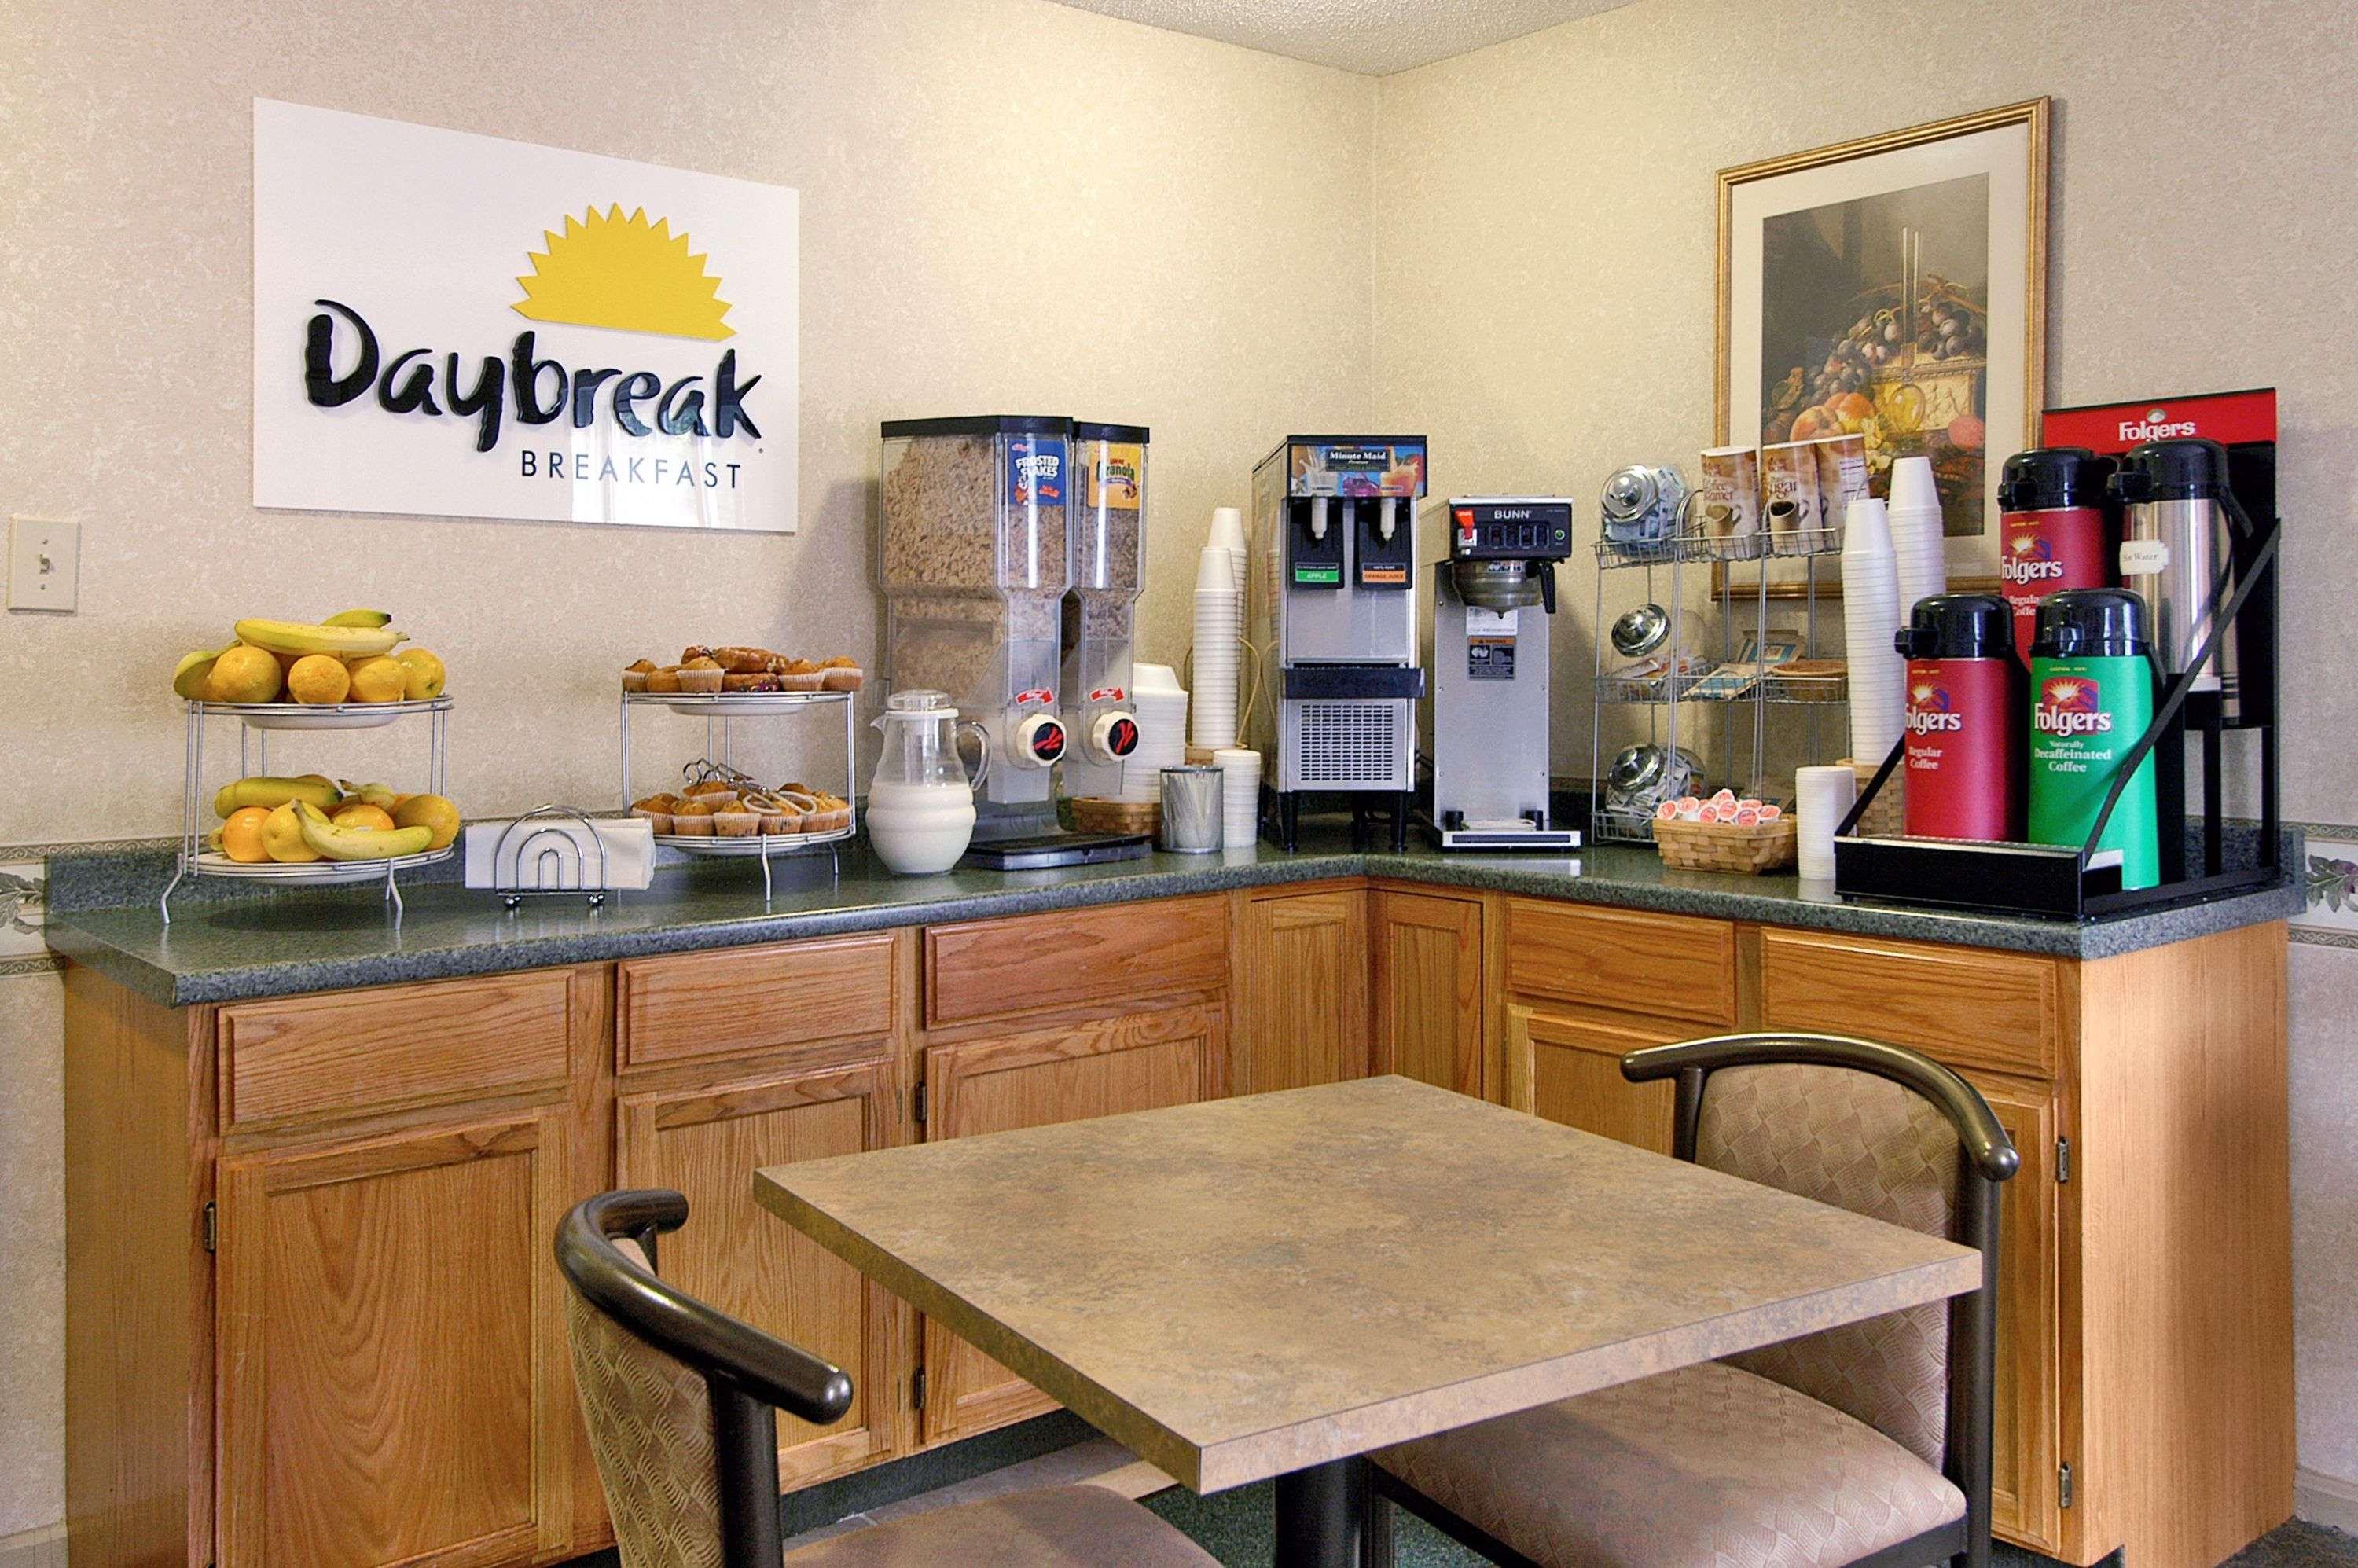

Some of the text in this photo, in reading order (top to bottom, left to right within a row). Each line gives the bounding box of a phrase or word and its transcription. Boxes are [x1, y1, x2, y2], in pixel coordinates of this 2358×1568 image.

[304, 299, 762, 452] Daybreak
[2118, 420, 2195, 442] Folgers
[1015, 455, 1060, 469] FROSTED
[1330, 451, 1386, 461] Minute Maid
[521, 449, 741, 490] BREAKFAST
[1494, 510, 1530, 519] BUNN
[2001, 555, 2063, 585] Folgers
[2009, 595, 2040, 606] Regula
[2013, 606, 2036, 616] Coffe
[1905, 703, 1962, 736] olgers
[2034, 703, 2112, 736] Folgers
[1908, 746, 1943, 759] Regular
[2034, 747, 2112, 761] Decaffeinated
[1910, 758, 1939, 770] Coffee
[2048, 760, 2088, 773] Coffee
